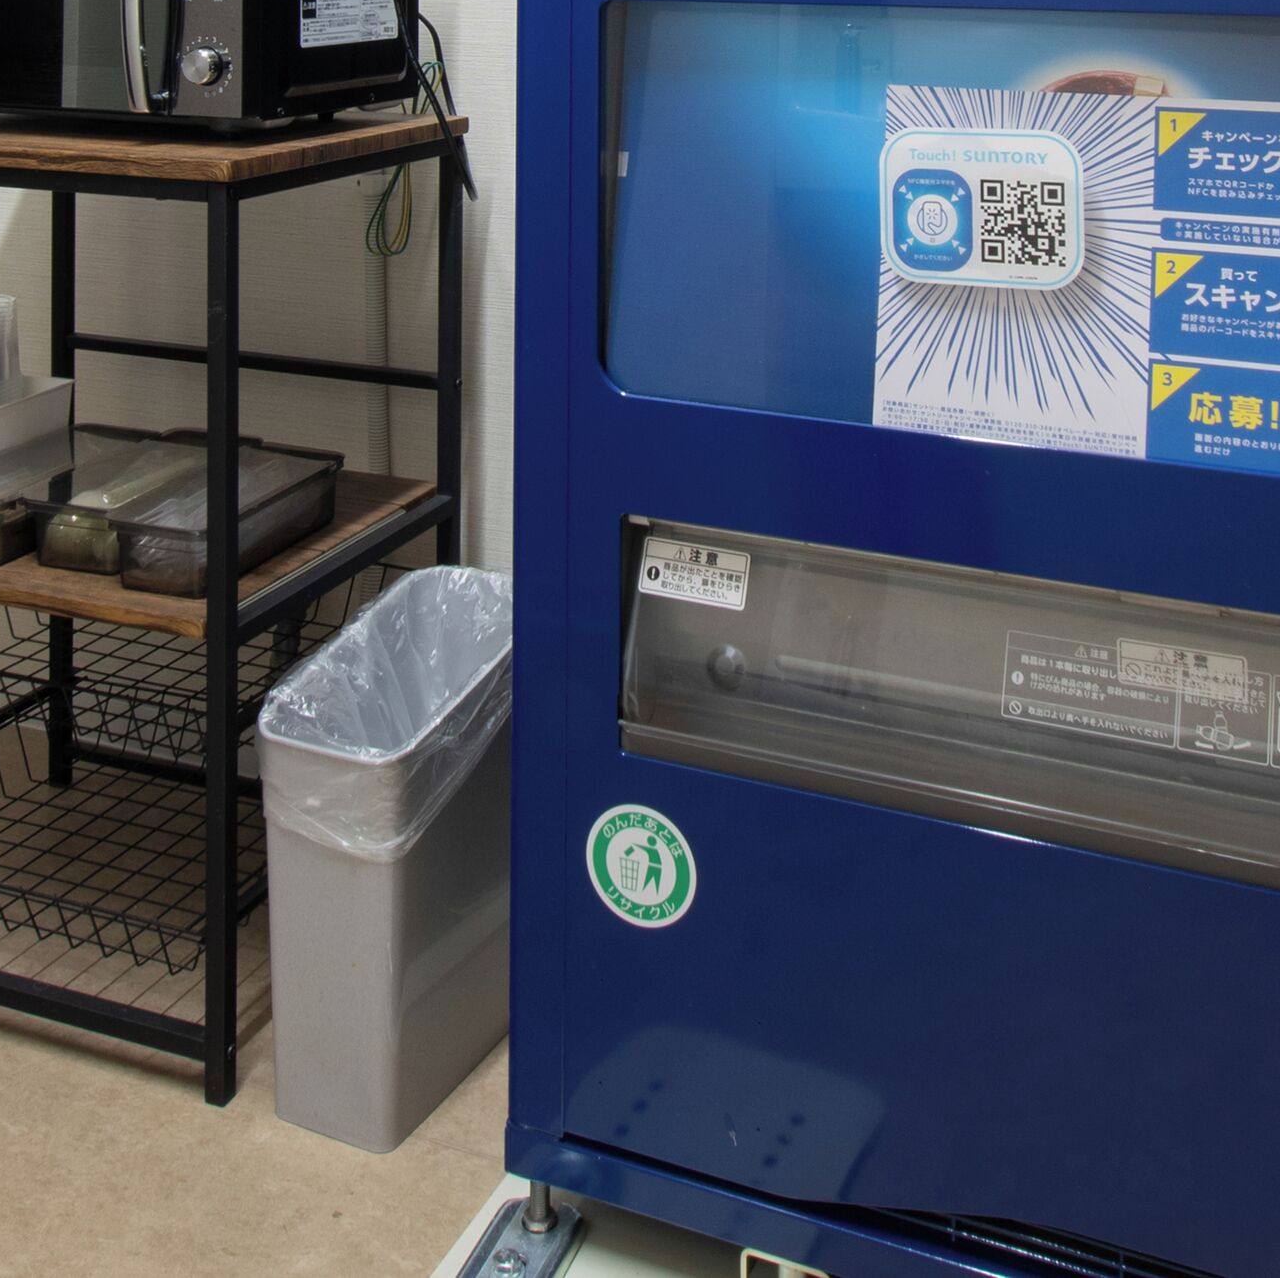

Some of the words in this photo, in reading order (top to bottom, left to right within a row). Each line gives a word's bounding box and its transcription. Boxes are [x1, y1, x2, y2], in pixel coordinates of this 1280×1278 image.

[1170, 118, 1178, 133] 1
[908, 148, 957, 163] Touch!
[963, 149, 1049, 165] SUNTORY
[1187, 177, 1275, 191] スマホでQRコードか
[1165, 260, 1177, 274] 2
[1220, 267, 1258, 282] 買って
[1162, 373, 1173, 387] 3
[688, 548, 720, 566] 注意
[602, 813, 684, 858] のんだあとは
[606, 885, 676, 921] リサイクル
